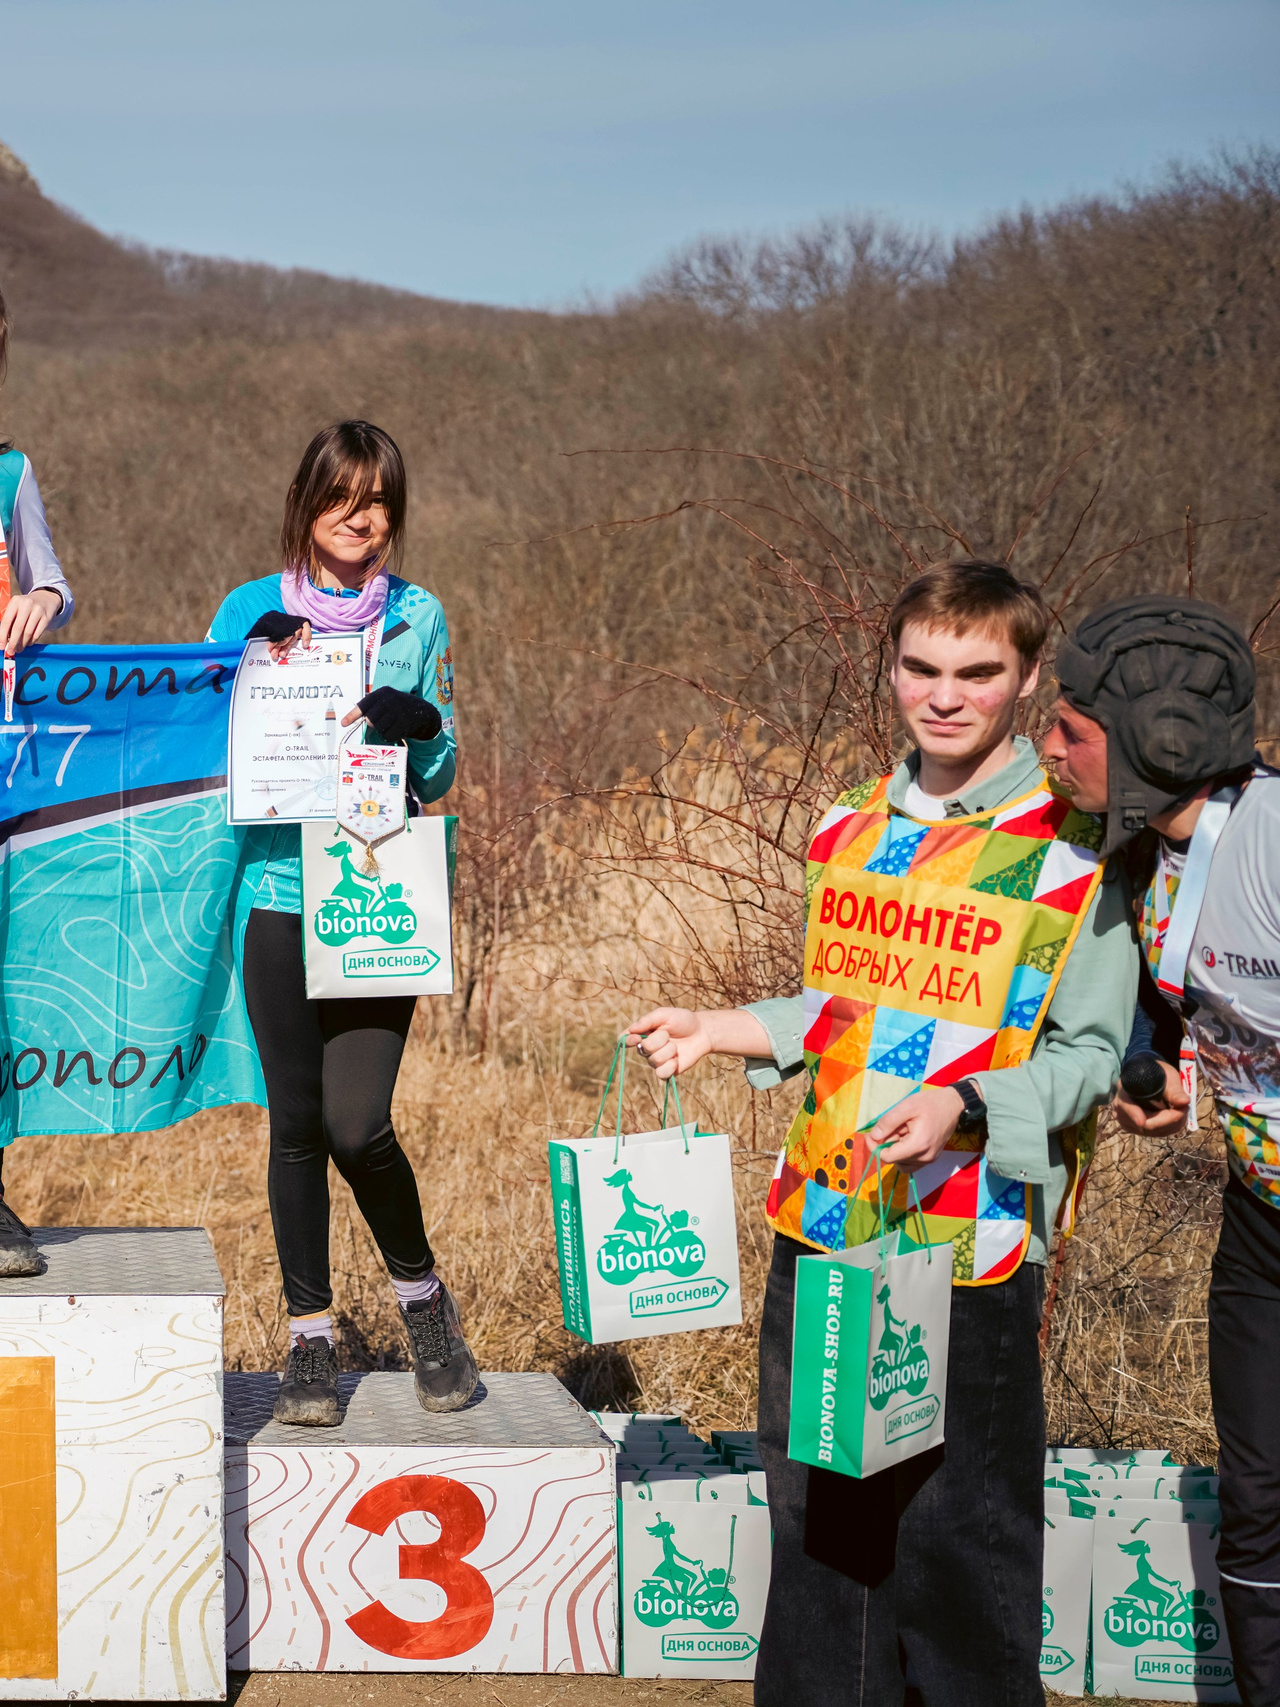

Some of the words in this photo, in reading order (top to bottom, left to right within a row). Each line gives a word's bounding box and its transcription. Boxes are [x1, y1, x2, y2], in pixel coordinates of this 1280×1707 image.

[250, 686, 344, 700] ГРАМОТА
[318, 911, 416, 935] bionova
[819, 887, 1002, 956] ВОЛОНТЁР
[348, 957, 374, 970] ДНЯ
[378, 955, 430, 969] ОСНОВА
[812, 938, 914, 991] ДОБРЫХ
[919, 963, 982, 1007] ДЕЛ
[560, 1198, 576, 1328] ПОДПИШИСЬ
[600, 1243, 704, 1274] bionova
[635, 1290, 664, 1310] ДНЯ
[666, 1286, 719, 1304] ОСНОВА
[818, 1269, 844, 1464] BIONOVA-SHOP.RU
[870, 1358, 929, 1399] bionova
[888, 1416, 902, 1433] ДНЯ
[904, 1404, 936, 1427] ОСНОВА
[345, 1474, 495, 1660] 3
[638, 1590, 737, 1618] bionova
[1108, 1608, 1218, 1642] bionova
[666, 1640, 694, 1653] ДНЯ
[697, 1640, 750, 1652] ОСНОВА
[1140, 1660, 1170, 1674] ДНЯ
[1174, 1663, 1232, 1678] ОСНОВА
